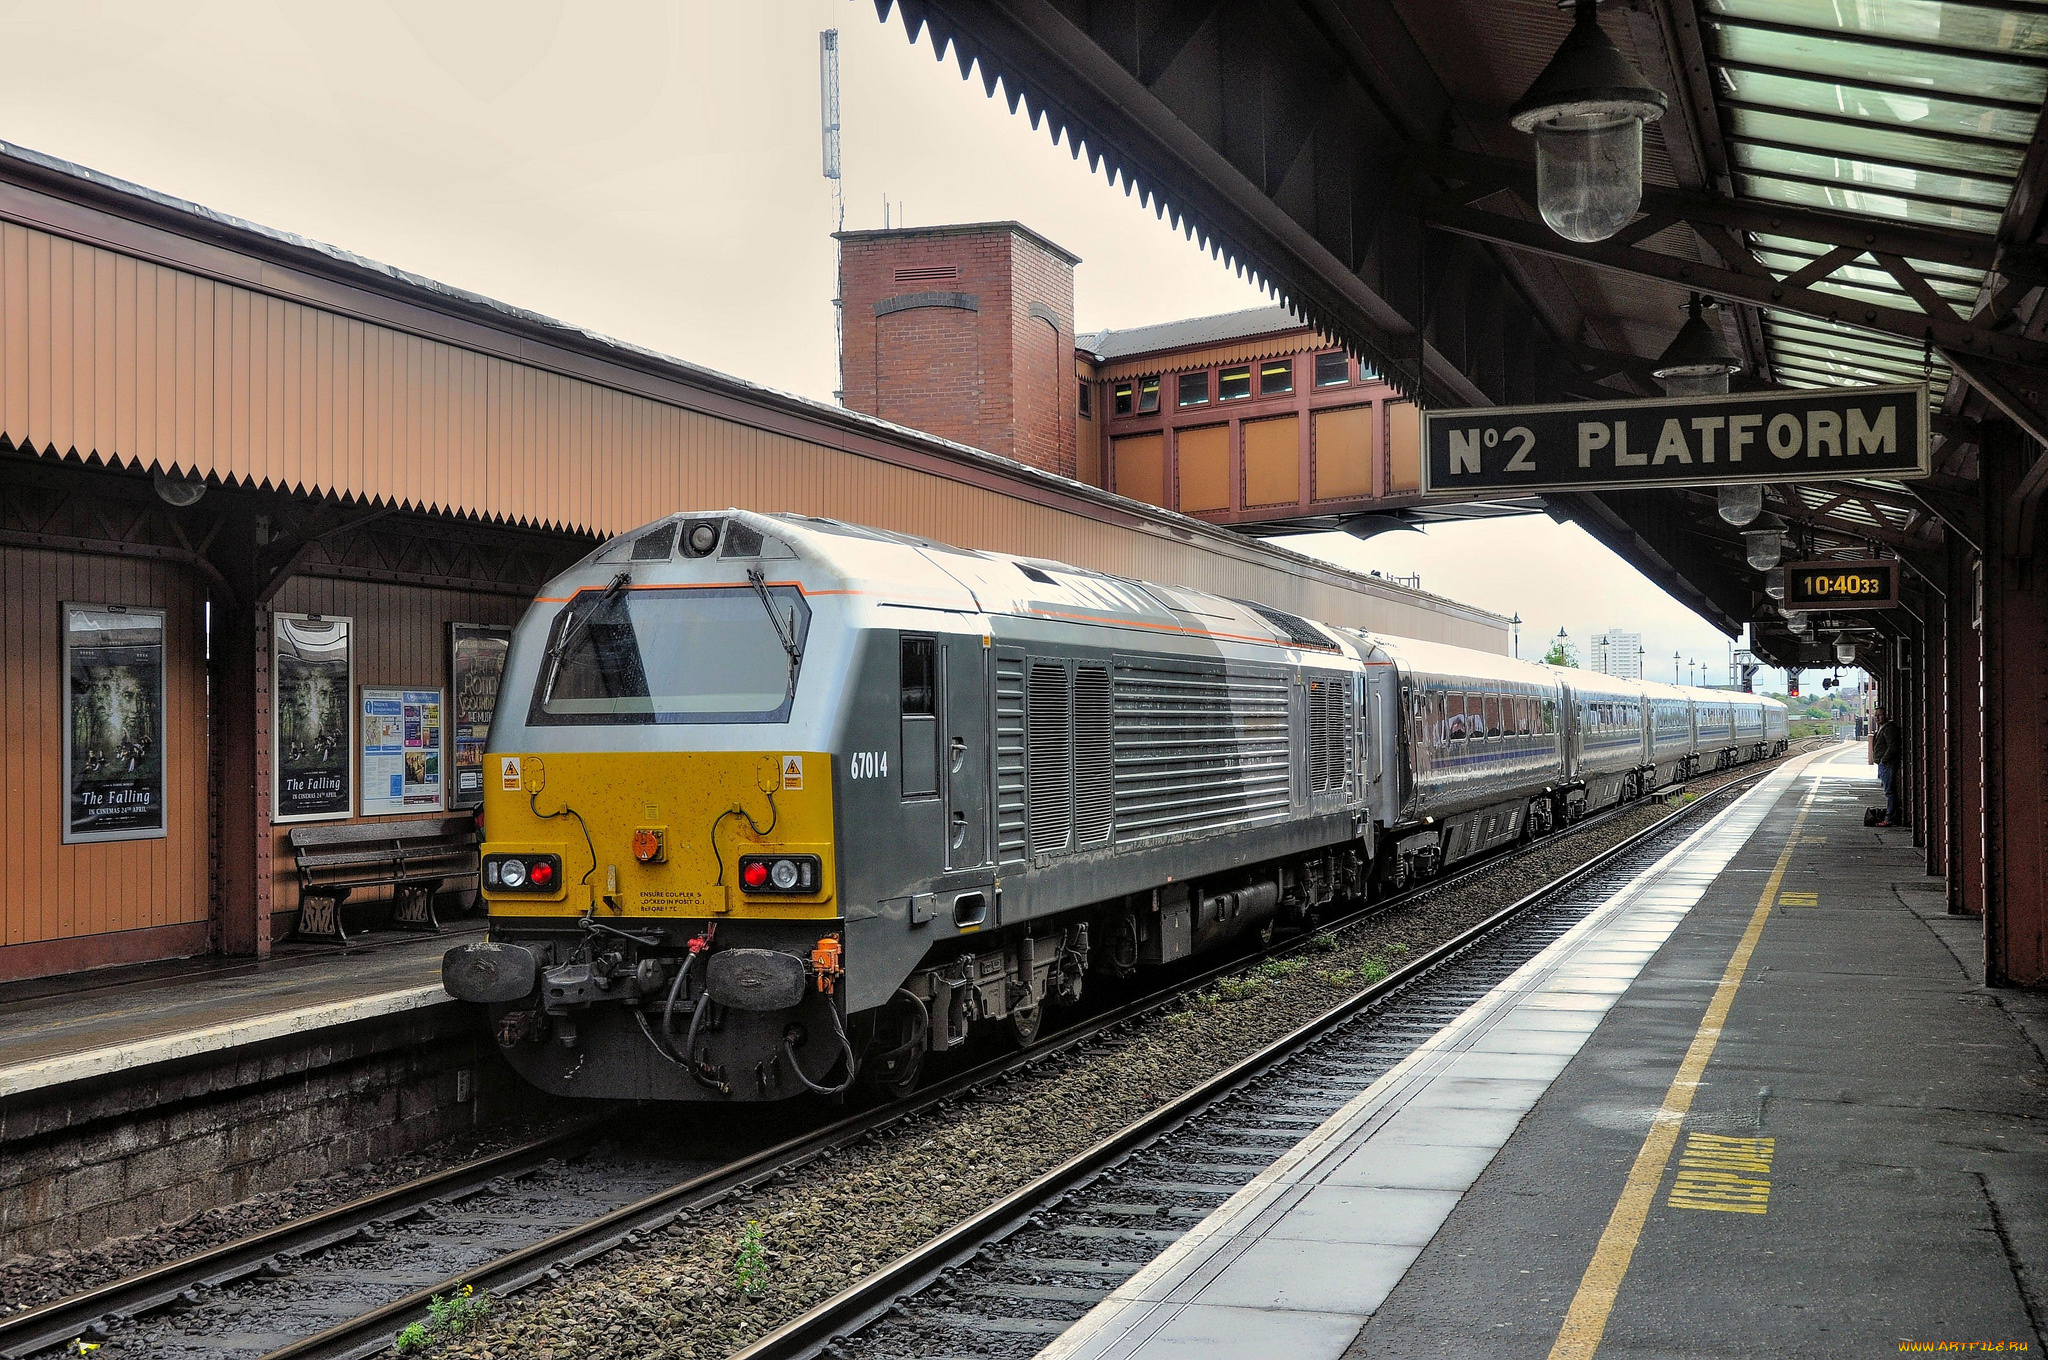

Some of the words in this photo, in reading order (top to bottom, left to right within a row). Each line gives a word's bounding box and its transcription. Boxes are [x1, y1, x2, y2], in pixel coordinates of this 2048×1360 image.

[1578, 405, 1897, 468] PLATFORM
[851, 751, 888, 779] 67014
[82, 791, 103, 805] The
[109, 789, 150, 804] Falling
[286, 778, 304, 791] The
[307, 777, 341, 791] Falling
[96, 807, 120, 815] CINEMAS
[1679, 1132, 1775, 1173] BACK
[1668, 1170, 1771, 1214] KEEP
